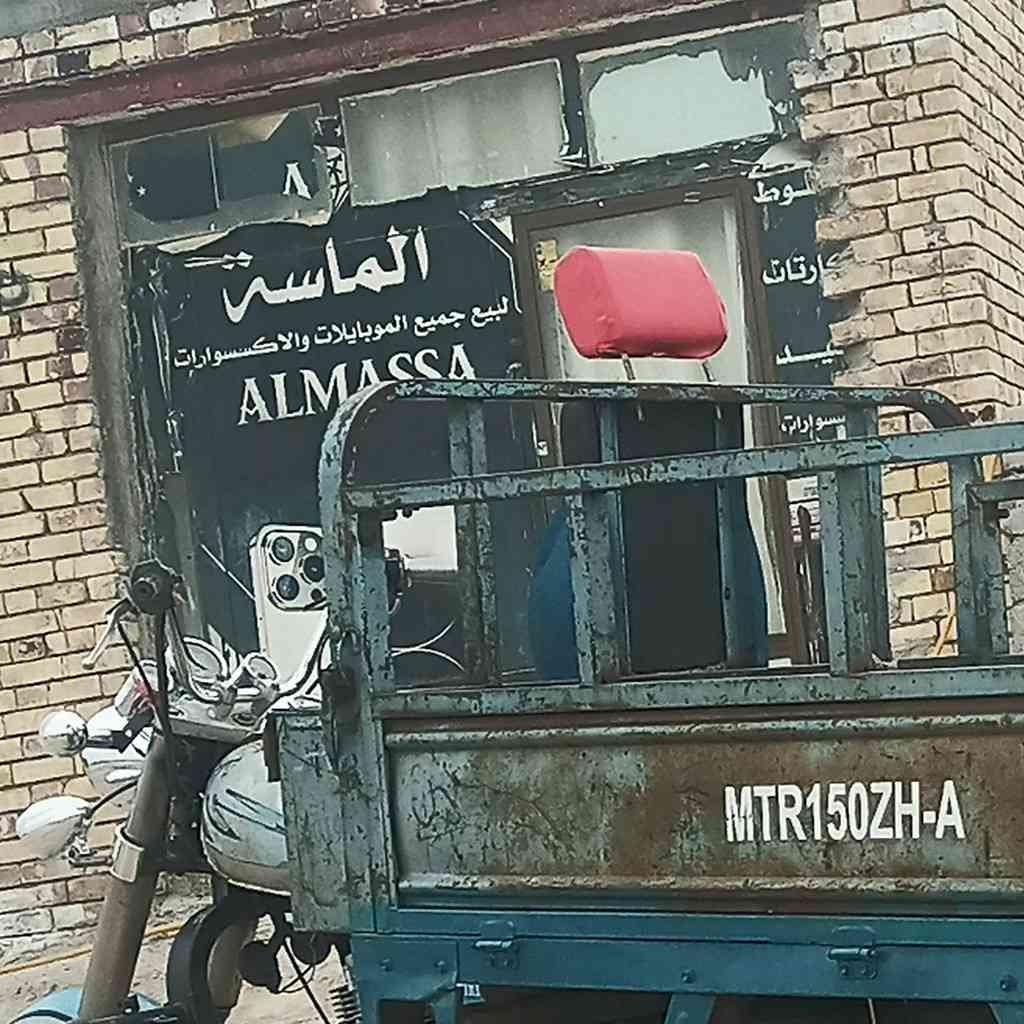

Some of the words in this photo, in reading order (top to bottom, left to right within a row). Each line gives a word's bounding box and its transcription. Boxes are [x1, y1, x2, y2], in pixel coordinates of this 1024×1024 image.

[221, 223, 431, 324] الماسة
[314, 315, 409, 348] الموبايلات
[412, 311, 466, 336] جميع
[471, 296, 511, 327] لبيع
[237, 344, 476, 426] ALMASSA
[724, 779, 966, 842] MTR150ZH-A
